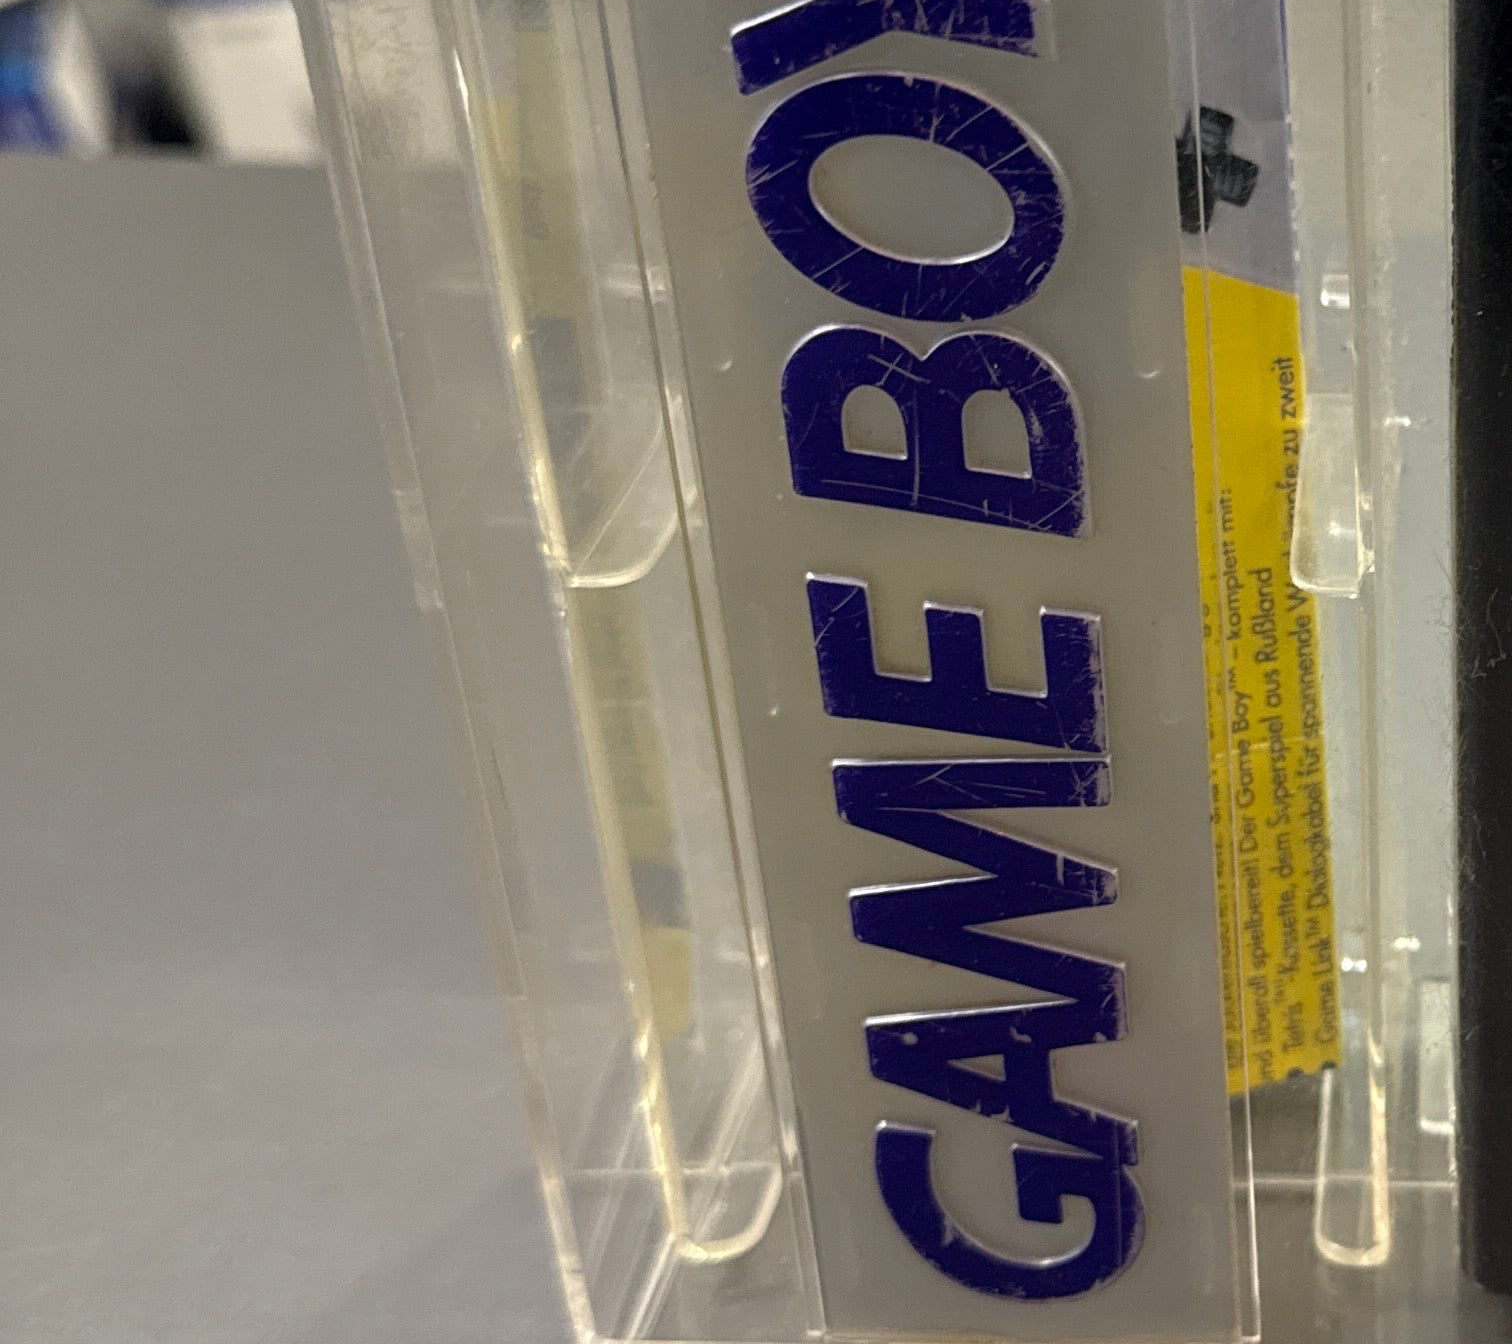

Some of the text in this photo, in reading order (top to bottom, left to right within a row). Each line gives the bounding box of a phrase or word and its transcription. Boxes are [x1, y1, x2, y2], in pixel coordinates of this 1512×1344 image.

[1271, 356, 1296, 419] zweit
[1282, 429, 1298, 455] zu
[1249, 567, 1278, 663] Rußland
[1261, 669, 1281, 708] aus
[1289, 616, 1319, 739] spannende
[1234, 739, 1255, 808] Game
[1259, 716, 1289, 825] Superspiel
[1297, 747, 1320, 777] für
[1238, 816, 1258, 852] Der
[1271, 832, 1294, 879] dem
[804, 571, 1146, 1304] GAME
